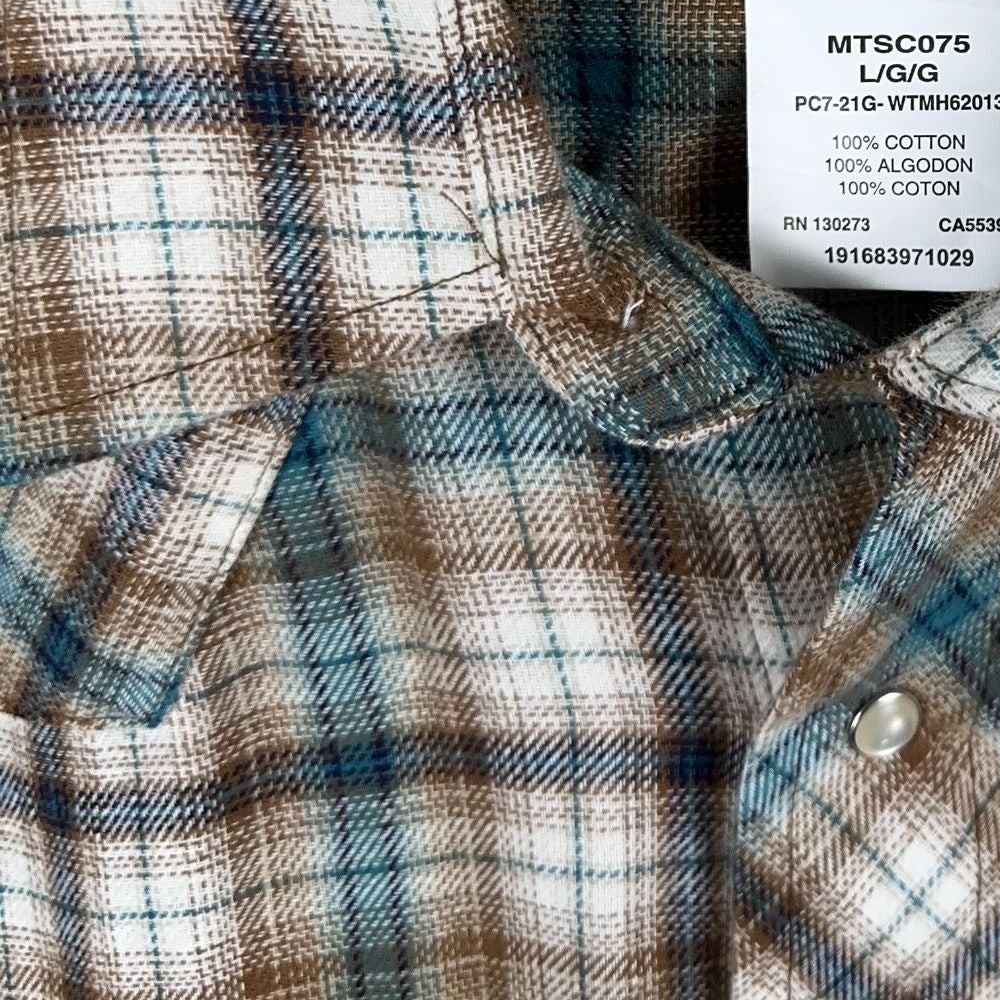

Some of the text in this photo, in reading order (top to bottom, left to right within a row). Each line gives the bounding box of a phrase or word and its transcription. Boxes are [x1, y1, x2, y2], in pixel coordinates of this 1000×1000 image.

[827, 34, 971, 54] MTSC075
[859, 63, 939, 84] L/G/G
[832, 134, 966, 151] 100% COTTON
[824, 157, 973, 174] 100% ALGODON
[838, 180, 960, 196] 100% COTON
[783, 216, 871, 232] RN 130273
[823, 246, 975, 267] 191683971029
